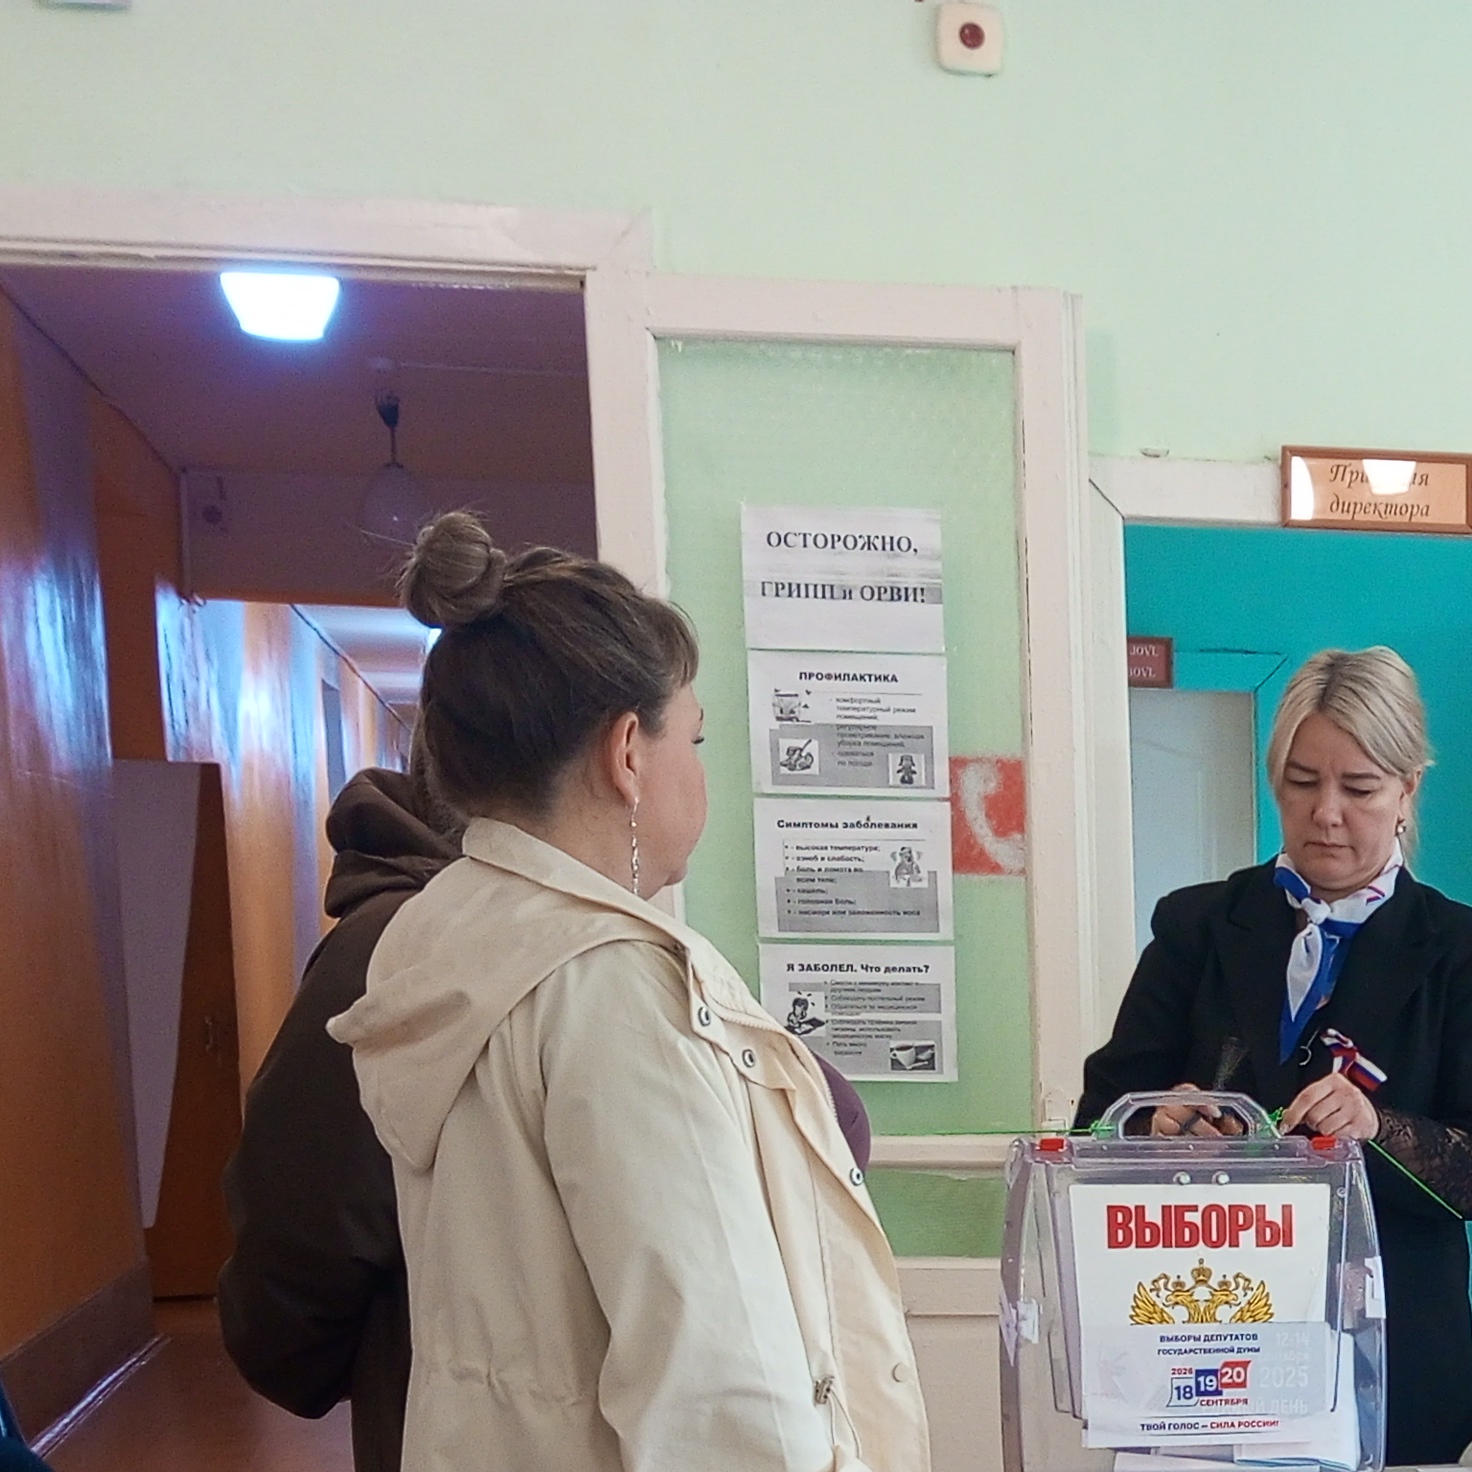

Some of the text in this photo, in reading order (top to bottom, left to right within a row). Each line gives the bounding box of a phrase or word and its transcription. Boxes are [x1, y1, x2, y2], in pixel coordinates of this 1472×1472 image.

[1329, 463, 1429, 488] Прия
[1330, 493, 1430, 521] директора
[766, 531, 919, 555] ОСТОРОЖНО,
[761, 580, 926, 603] ГРИПП и ОРВИ!
[799, 672, 899, 683] ПРОФИЛАКТИКА
[777, 819, 919, 830] Симптомы заболевания
[786, 963, 930, 974] Я ЗАБОЛЕЛ. Что делать?
[1107, 1204, 1293, 1249] ВЫБОРЫ
[1159, 1333, 1259, 1343] ВЫБОРЫ ДЕПУТАТОВ
[1157, 1346, 1260, 1356] ГОСУДАРСТВЕННОЙ ДУМЫ
[1171, 1367, 1193, 1376] 2026
[1260, 1365, 1310, 1388] 2025
[1174, 1367, 1245, 1401] 18 19 20
[1200, 1398, 1249, 1407] СЕНТЯБРЯ
[1140, 1422, 1166, 1432] ТВОЙ
[1167, 1421, 1199, 1431] ГОЛОС
[1210, 1420, 1236, 1430] СИЛА
[1238, 1419, 1279, 1429] РОССИИ!
